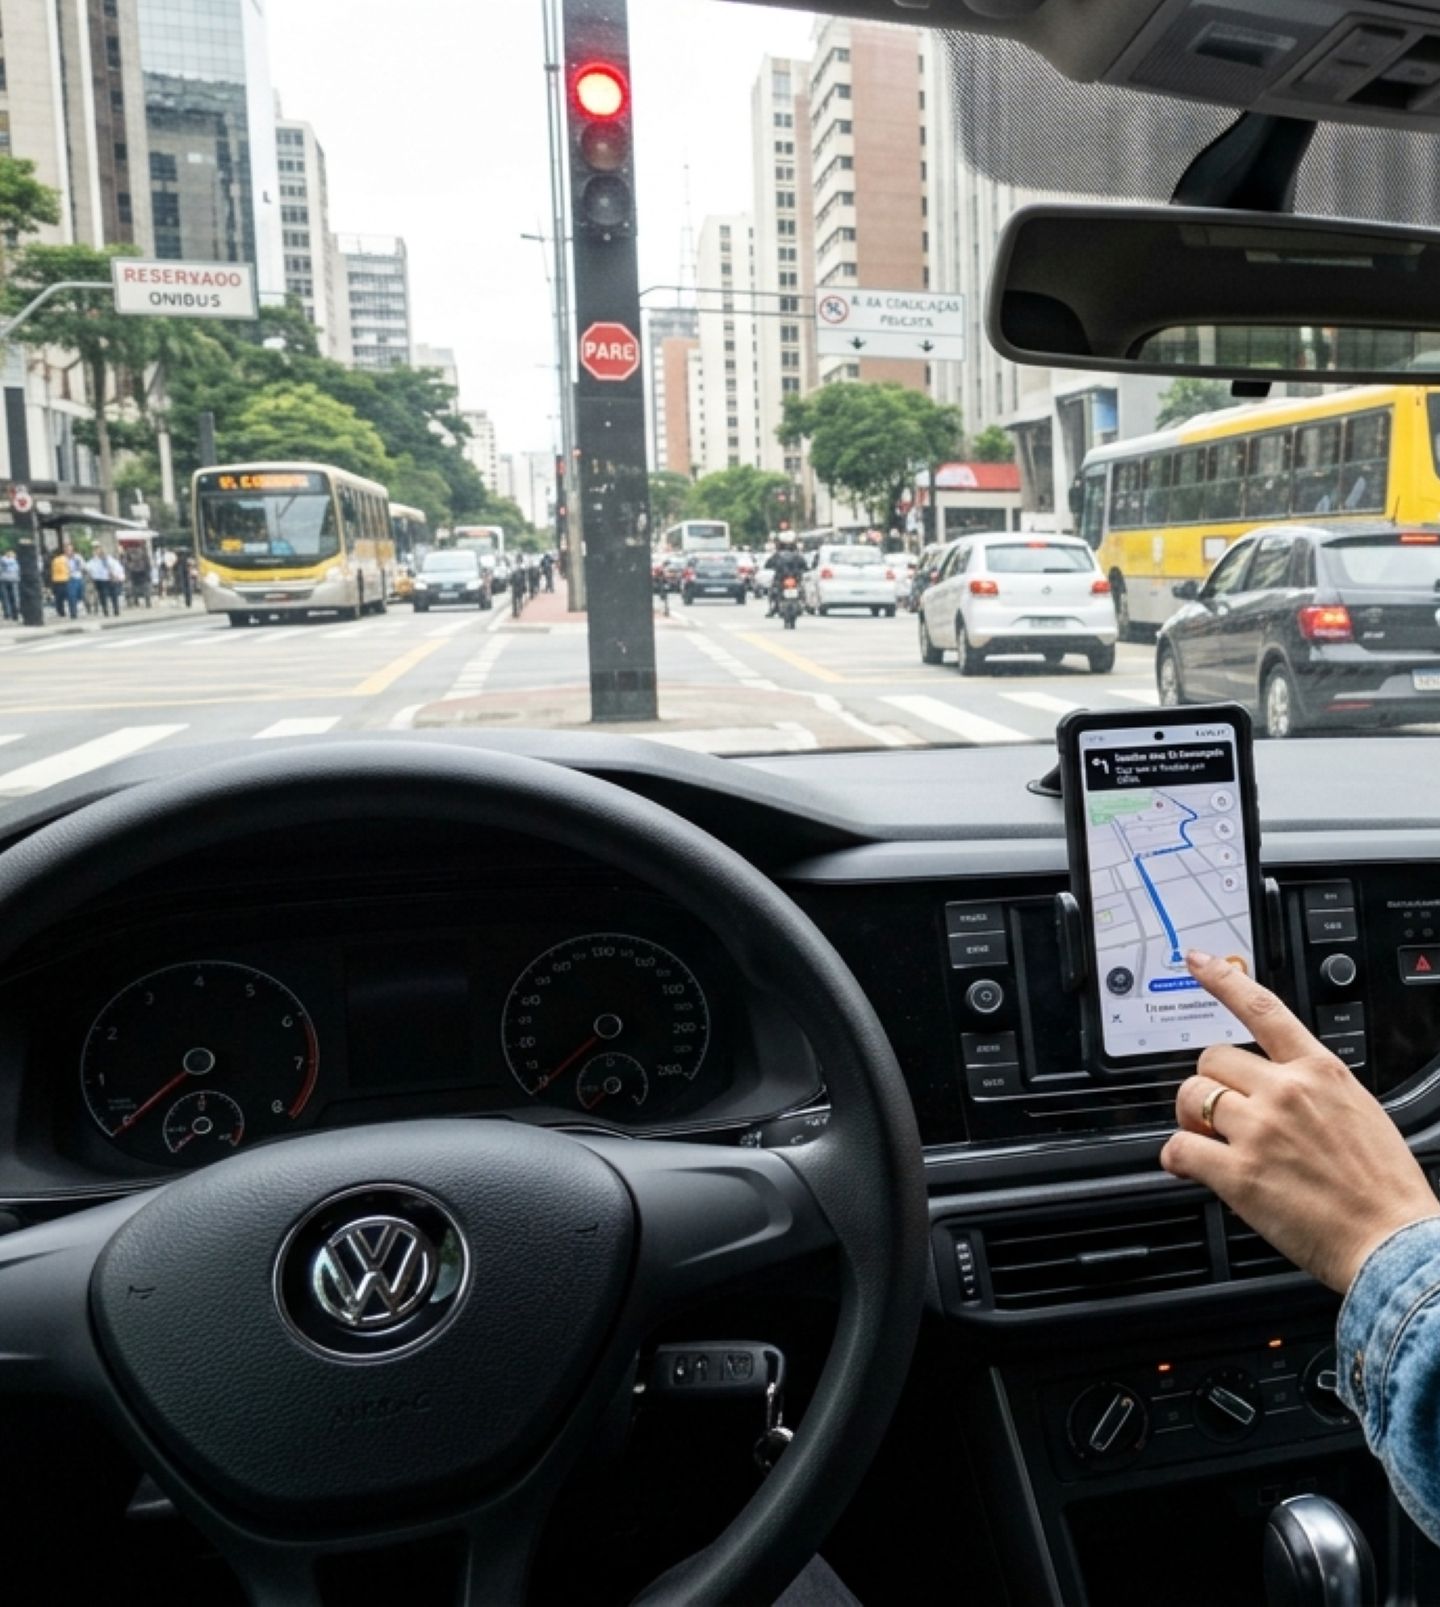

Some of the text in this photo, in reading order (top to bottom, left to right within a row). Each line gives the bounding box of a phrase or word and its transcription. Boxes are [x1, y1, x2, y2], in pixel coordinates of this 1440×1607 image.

[584, 342, 635, 361] PARE
[194, 975, 204, 987] 4
[245, 983, 256, 997] 5
[145, 992, 154, 1005] 3
[281, 1015, 293, 1028] 6
[107, 1027, 118, 1040] 2
[293, 1056, 303, 1071] 7
[315, 1217, 431, 1325] VW
